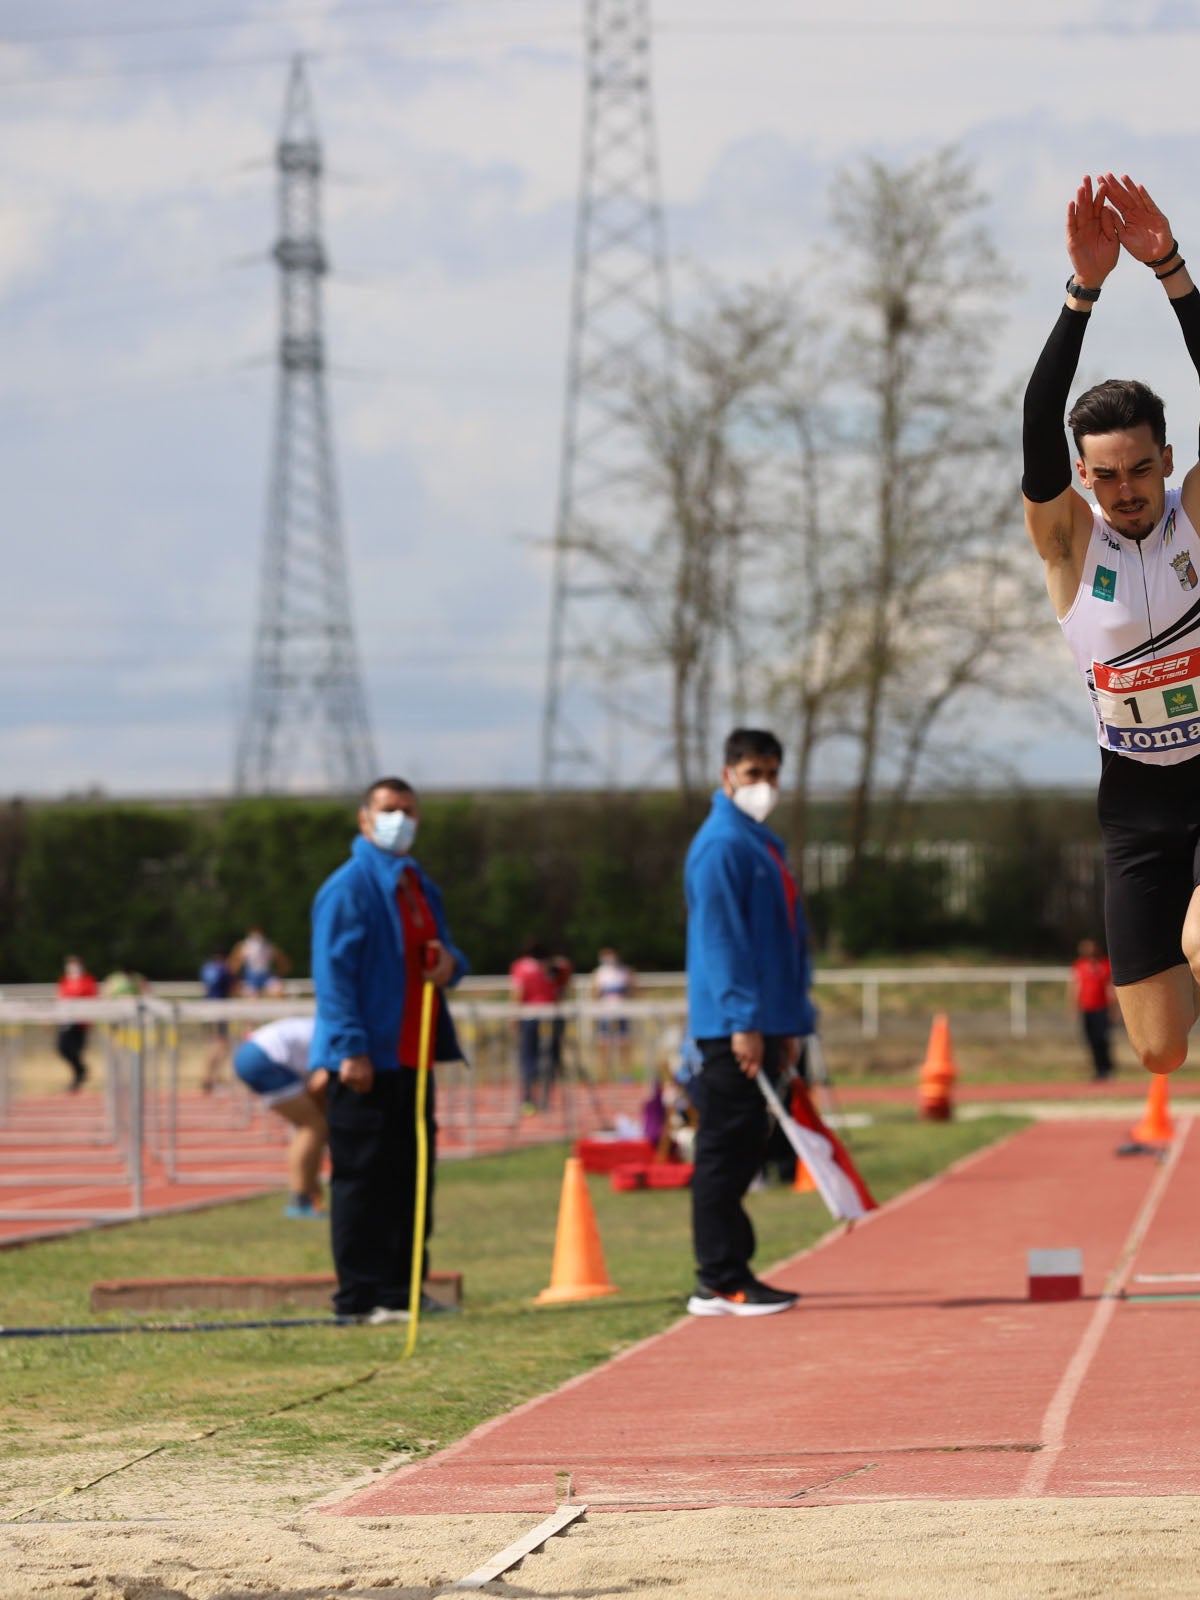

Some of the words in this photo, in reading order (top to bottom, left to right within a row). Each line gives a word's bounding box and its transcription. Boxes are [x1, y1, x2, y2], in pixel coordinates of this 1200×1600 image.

[1136, 656, 1190, 677] RFEA
[1135, 669, 1188, 687] ATLETISMO
[1123, 697, 1142, 723] 1
